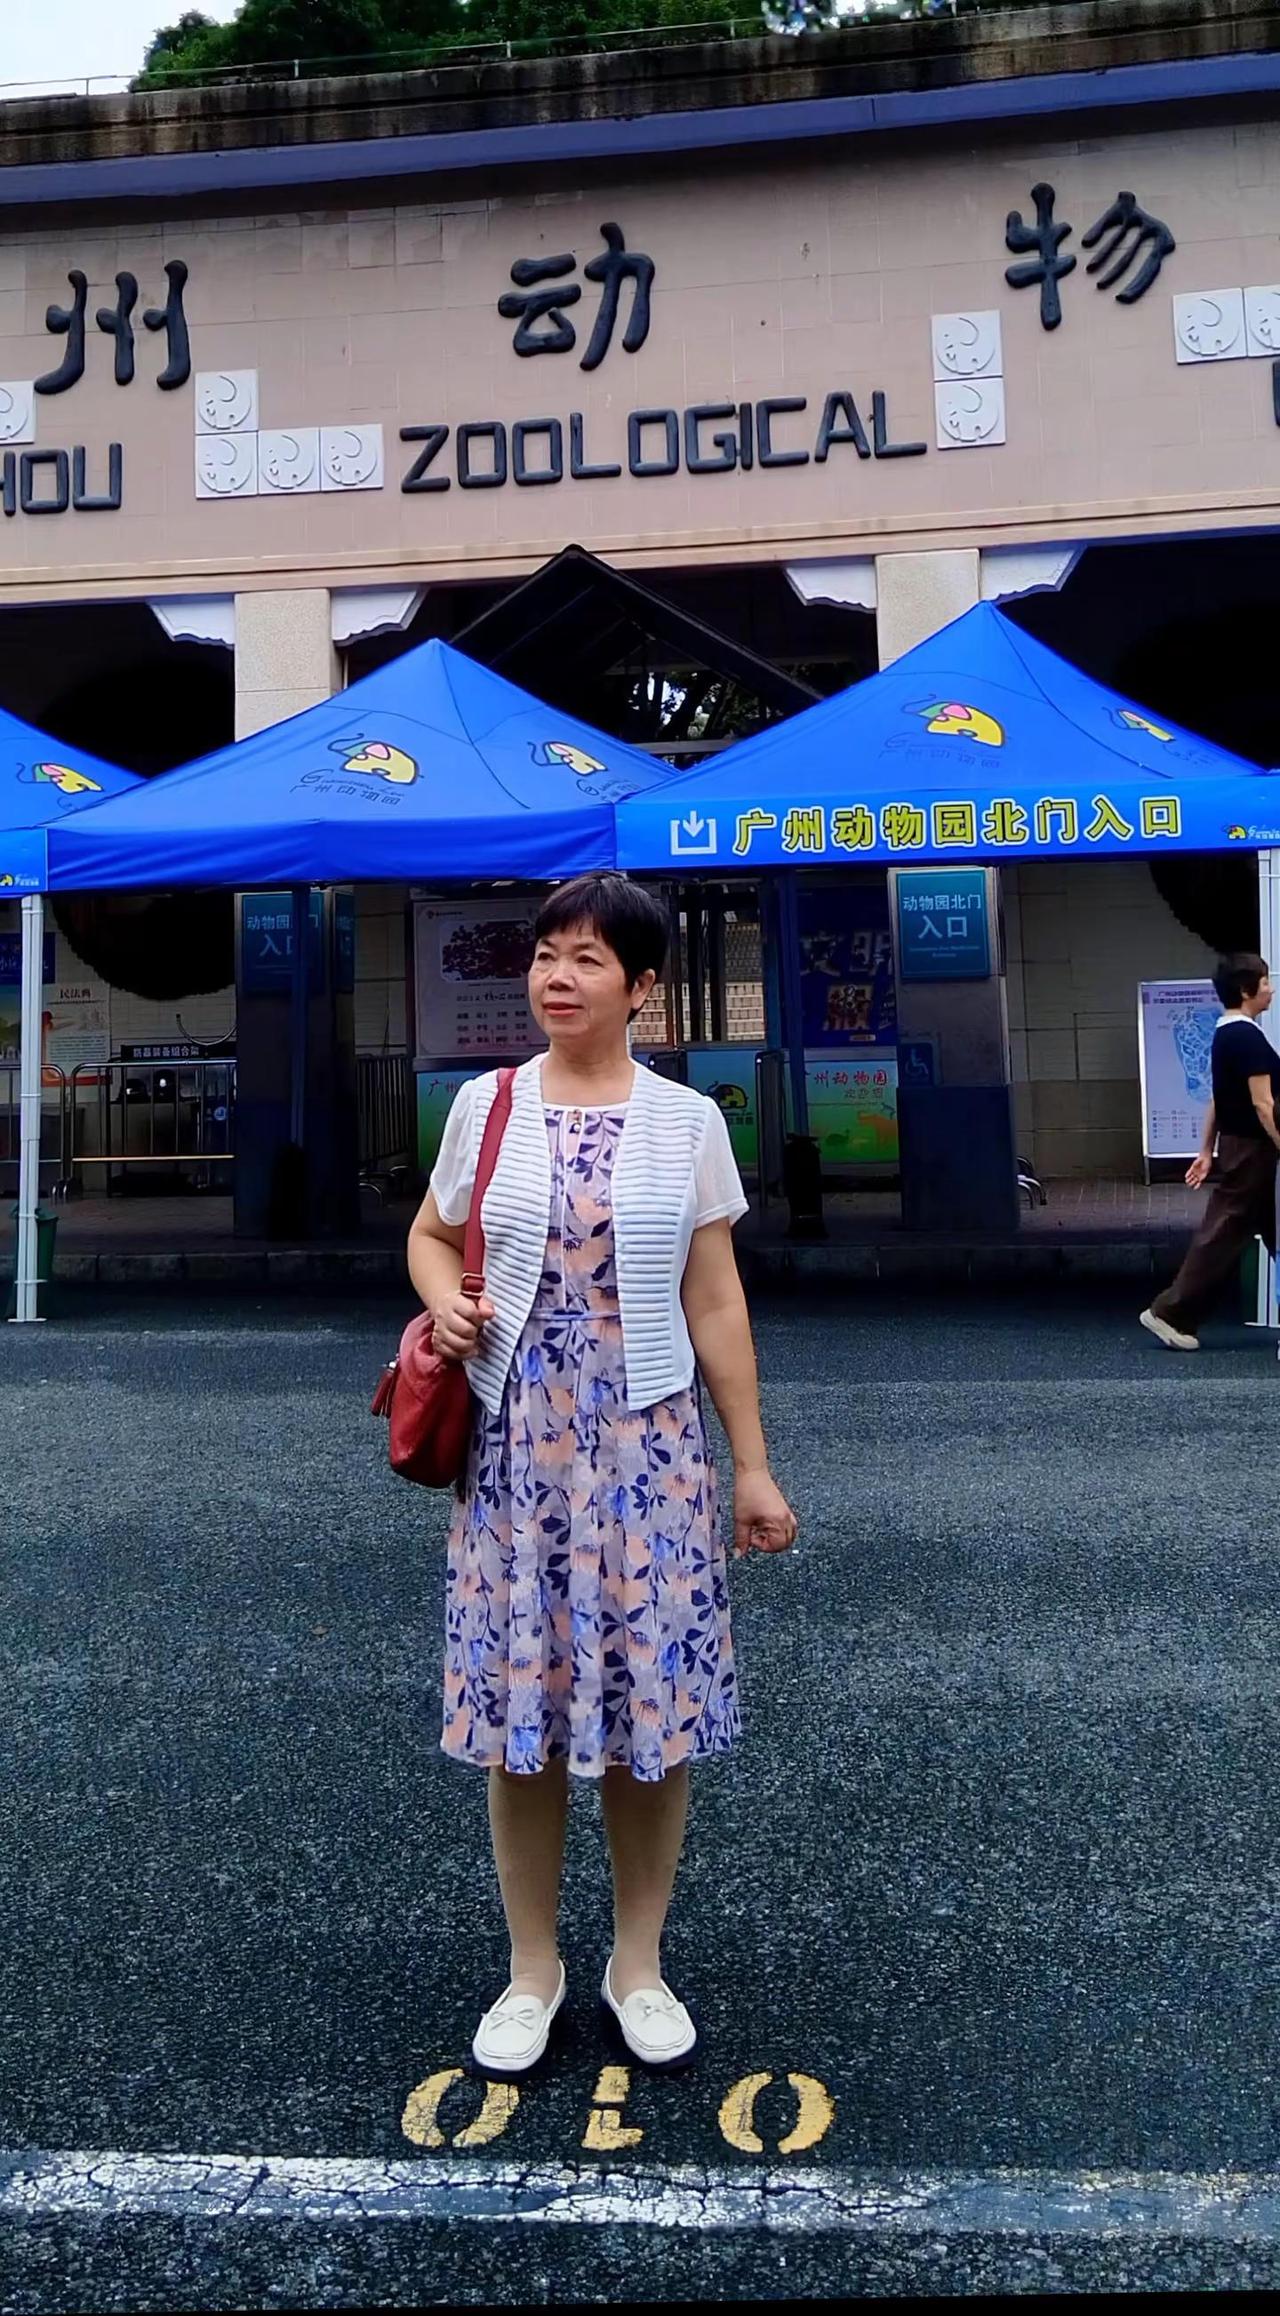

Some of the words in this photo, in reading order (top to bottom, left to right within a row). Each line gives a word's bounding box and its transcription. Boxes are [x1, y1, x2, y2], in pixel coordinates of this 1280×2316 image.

[34, 260, 191, 394] 州
[498, 222, 655, 371] 动
[1005, 183, 1175, 330] 物
[400, 390, 928, 493] ZOOLOGICAL
[733, 794, 1183, 856] 广州动物园北门入口
[902, 893, 981, 912] 动物园北门
[917, 914, 968, 940] 入口
